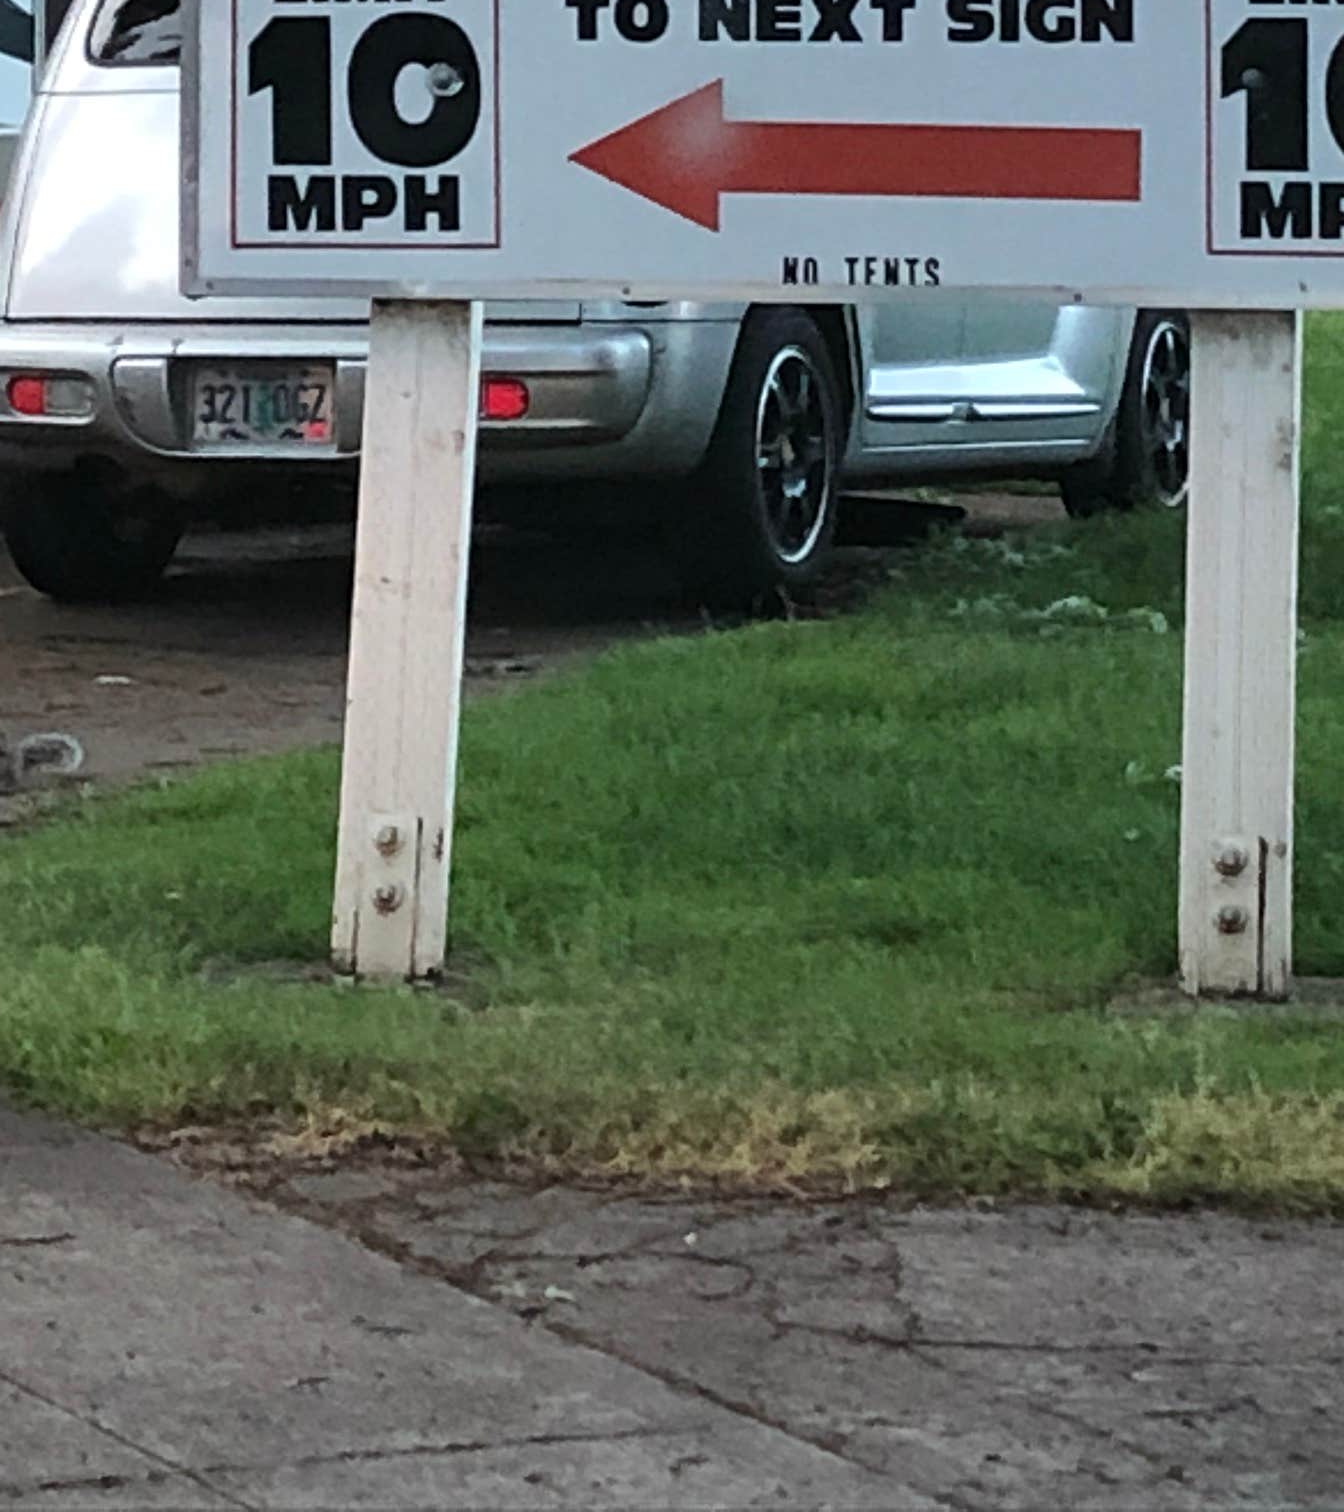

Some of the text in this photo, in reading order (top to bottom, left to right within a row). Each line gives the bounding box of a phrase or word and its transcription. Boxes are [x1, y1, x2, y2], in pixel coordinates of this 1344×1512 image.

[248, 11, 481, 169] 10
[267, 175, 460, 232] MPH
[781, 256, 940, 286] NO TENTS
